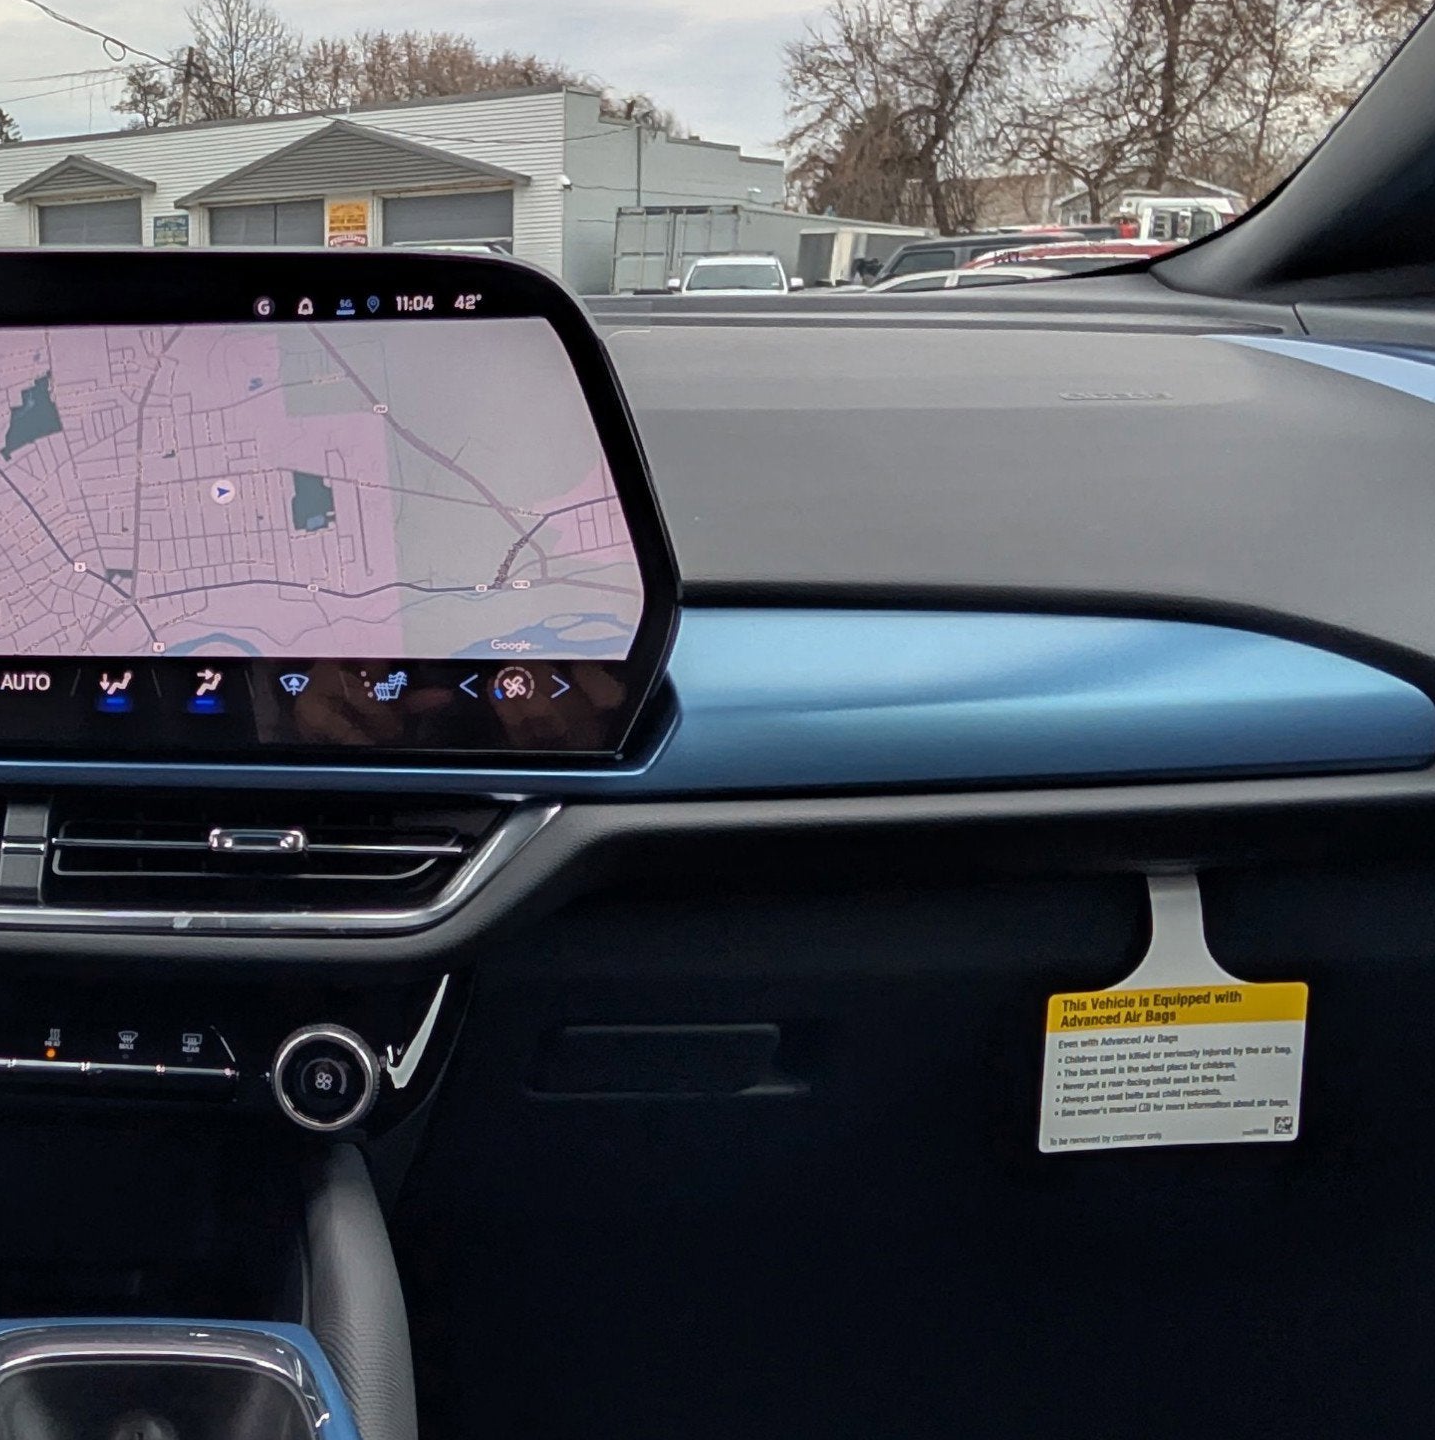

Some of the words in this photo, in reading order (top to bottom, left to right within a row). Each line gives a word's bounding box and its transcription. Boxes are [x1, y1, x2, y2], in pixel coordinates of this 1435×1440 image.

[395, 295, 434, 311] 11:04
[454, 294, 482, 310] 42°
[491, 639, 531, 653] Google
[0, 673, 51, 691] AUTO
[1062, 1000, 1087, 1012] This
[1091, 996, 1135, 1010] Vehicle
[1153, 992, 1211, 1008] Equipped
[1214, 990, 1242, 1003] with
[1060, 1011, 1121, 1028] Advanced
[1124, 1010, 1143, 1023] Air
[1146, 1009, 1177, 1024] Bags
[1101, 1035, 1141, 1046] Advanced
[1143, 1034, 1155, 1043] Air
[1158, 1033, 1178, 1044] Bags
